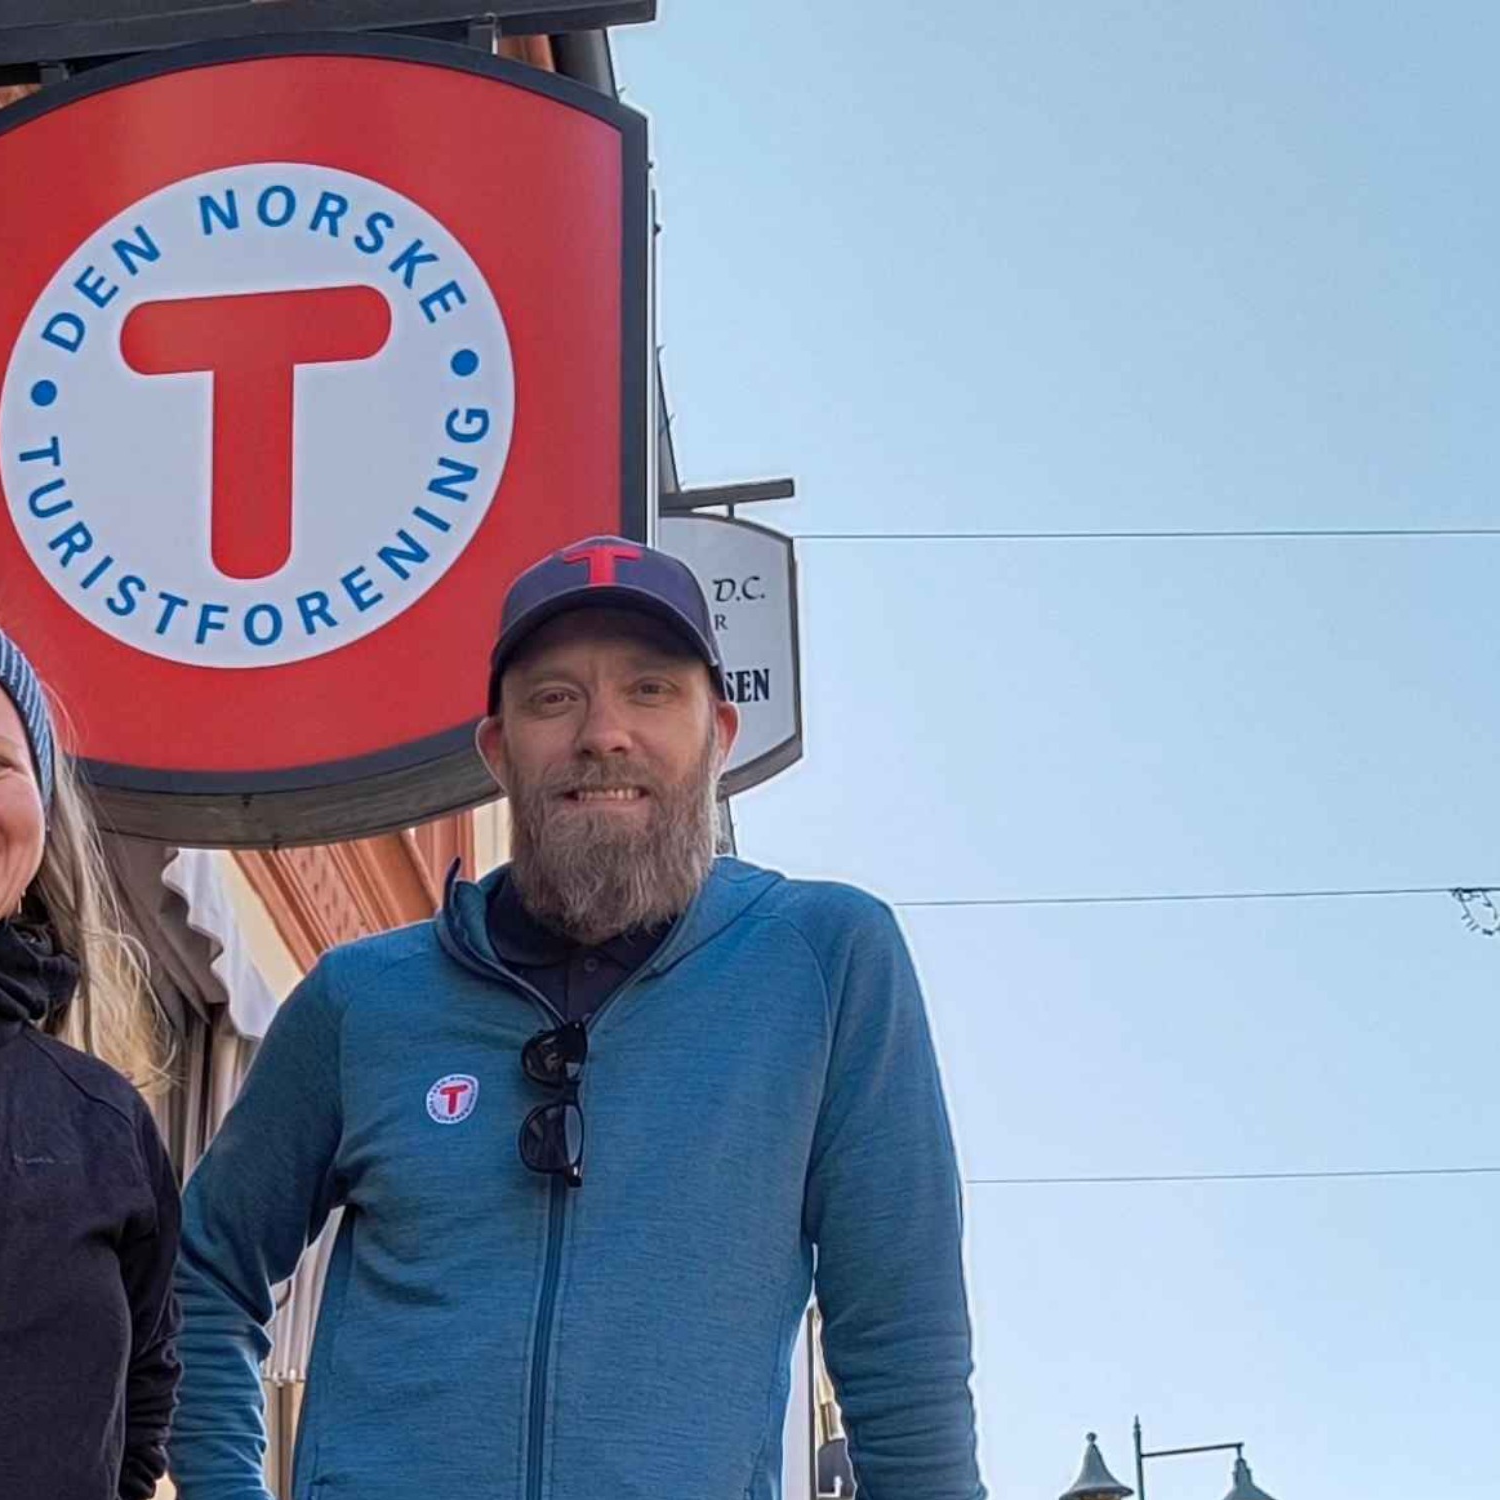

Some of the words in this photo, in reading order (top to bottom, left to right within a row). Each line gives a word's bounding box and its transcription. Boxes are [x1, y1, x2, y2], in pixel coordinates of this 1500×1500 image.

[41, 225, 161, 353] DEN
[198, 184, 468, 323] NORSKE
[18, 406, 490, 646] TURISTFORENING
[713, 575, 766, 602] D.C.
